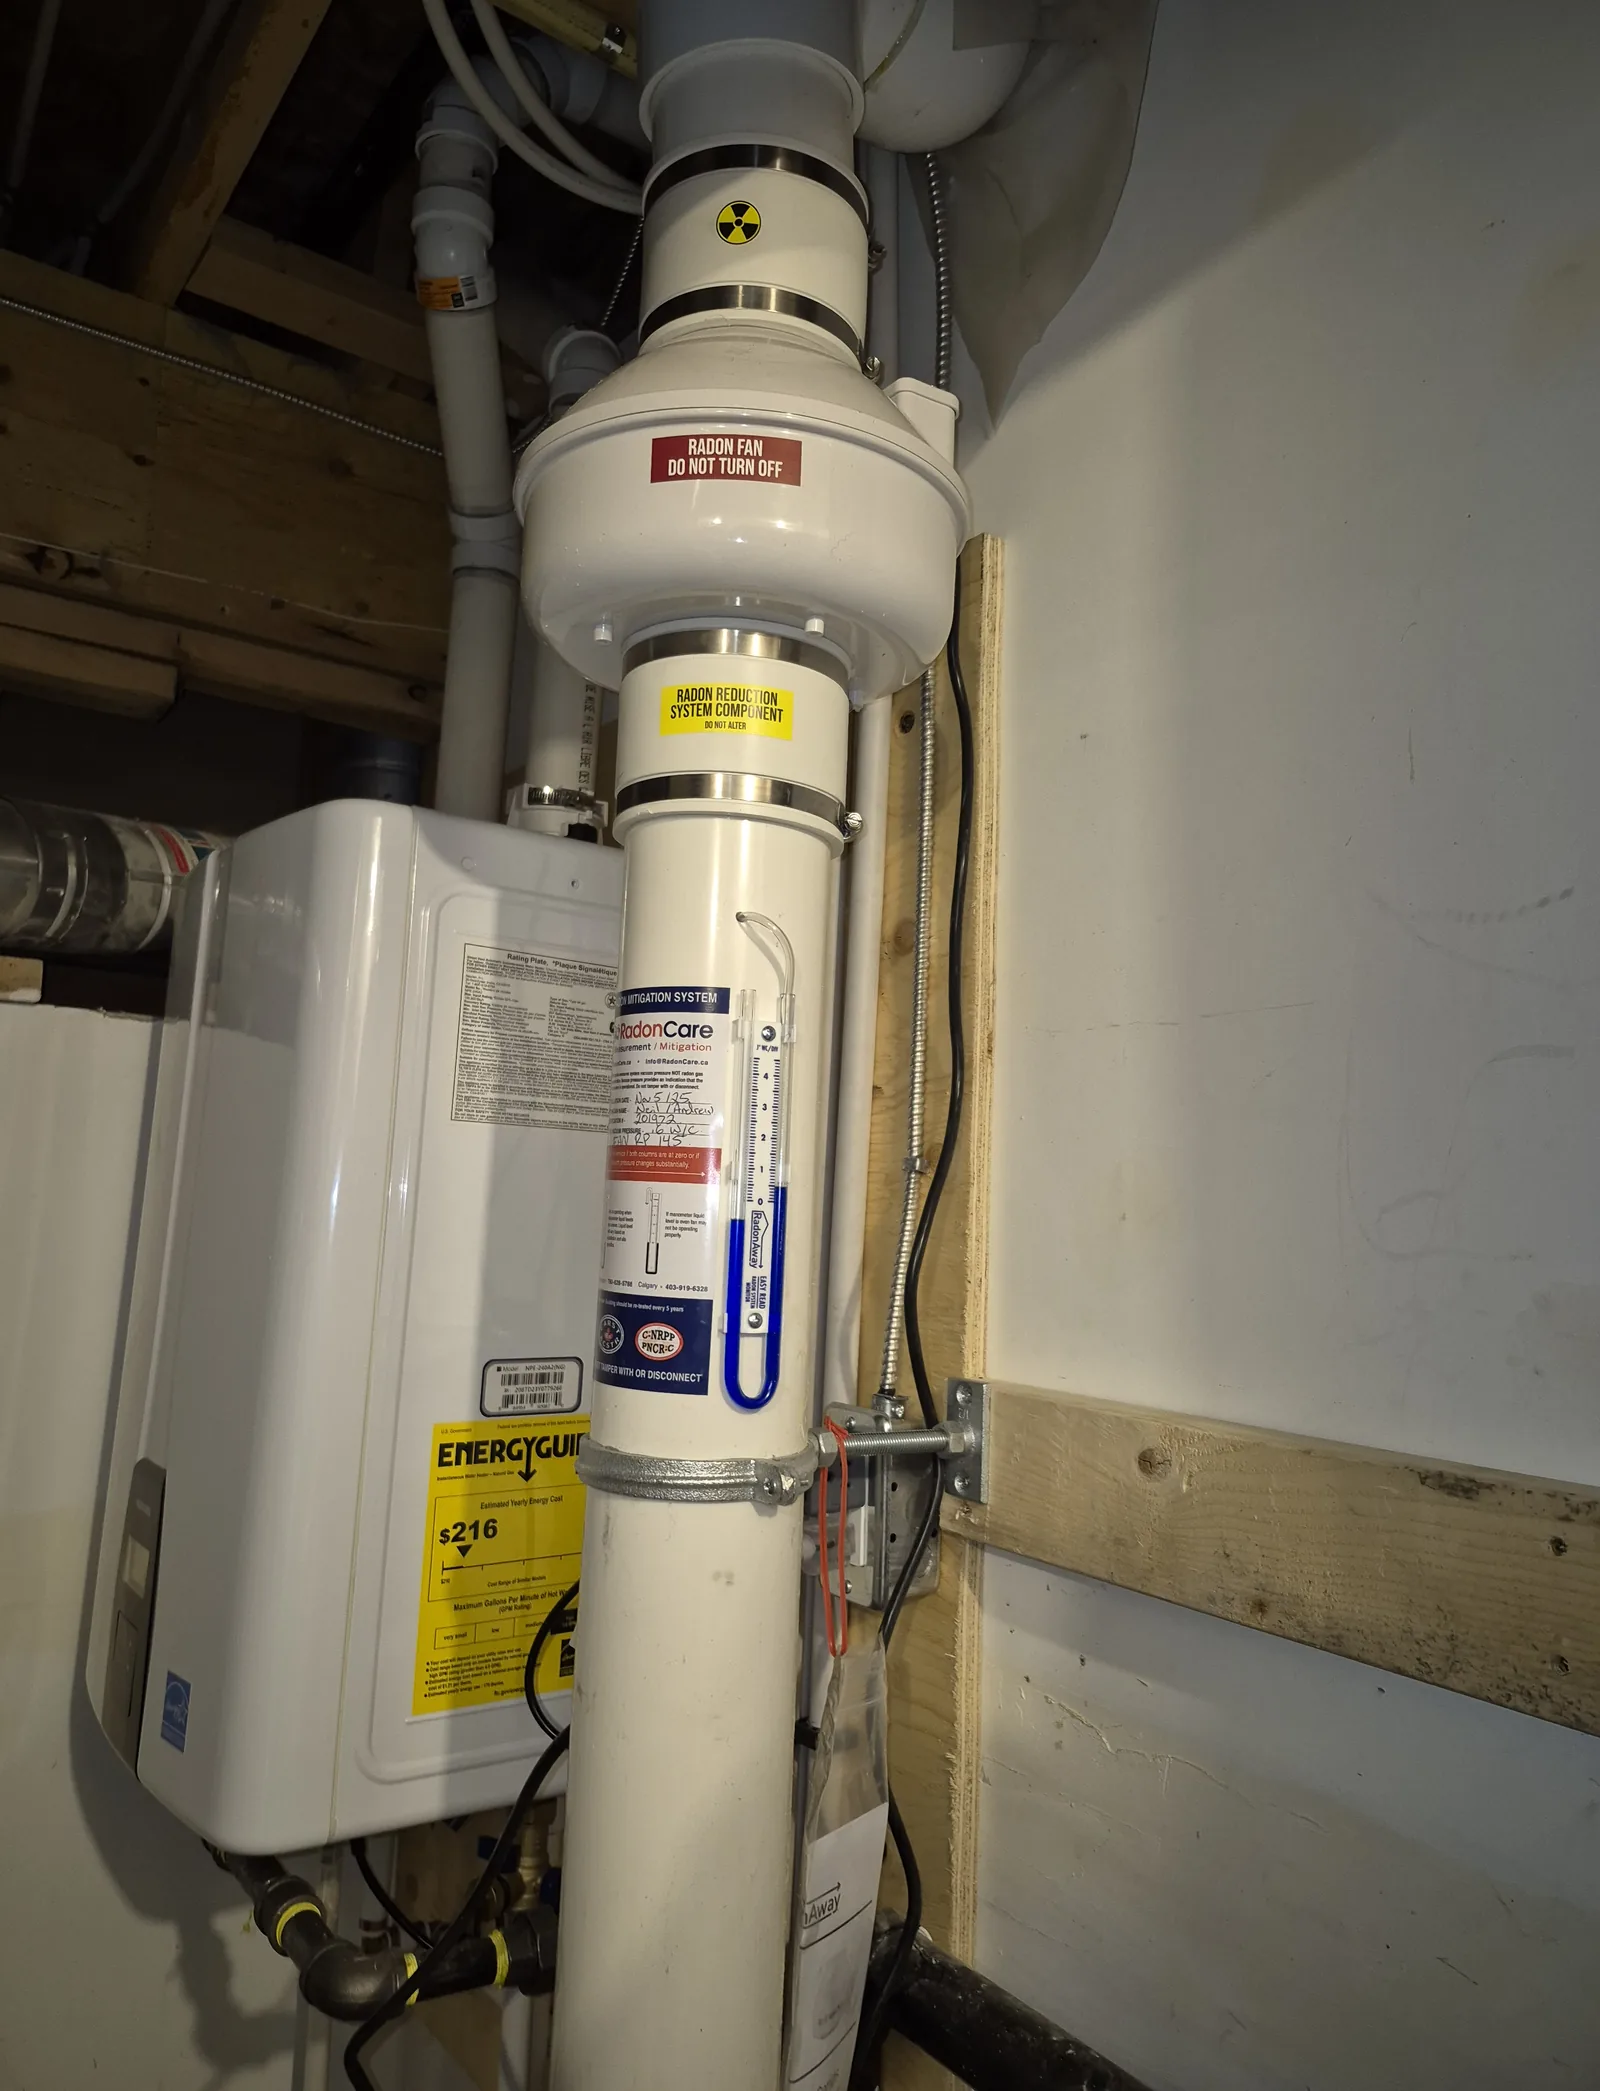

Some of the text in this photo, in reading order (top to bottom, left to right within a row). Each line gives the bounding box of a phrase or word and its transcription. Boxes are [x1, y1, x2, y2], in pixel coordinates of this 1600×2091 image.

[688, 438, 763, 456] RADON FAN
[668, 457, 783, 478] DO NOT TURN OFF
[677, 687, 778, 706] RADON REDUCTION
[670, 702, 784, 723] SYSTEM COMPONENT
[705, 721, 747, 730] DO NOT ALTER
[579, 747, 593, 768] LIBRE
[507, 953, 529, 964] Rating
[627, 992, 672, 1004] MITIGATION
[673, 992, 718, 1003] SYSTEM
[620, 1020, 713, 1039] RadonCare
[616, 1043, 652, 1052] surement
[660, 1042, 712, 1052] Mitigation
[636, 1101, 660, 1114] Neil
[673, 1101, 714, 1115] Andrew
[634, 1114, 676, 1125] 201972
[658, 1135, 682, 1147] 145
[758, 1198, 763, 1206] 0
[749, 1212, 762, 1269] RadonAway
[637, 1281, 658, 1290] Calgary
[759, 1293, 767, 1309] READ
[619, 1366, 634, 1377] WITH
[635, 1368, 646, 1378] OR
[647, 1370, 703, 1382] DISCONNECT
[480, 1495, 563, 1510] Estimated Yearly Energy Cost
[439, 1518, 498, 1546] $216
[454, 1603, 483, 1612] Maximum
[484, 1598, 507, 1608] Gallons
[508, 1596, 519, 1605] Per
[520, 1593, 539, 1601] Minute
[540, 1591, 546, 1599] of
[547, 1590, 558, 1598] Hot
